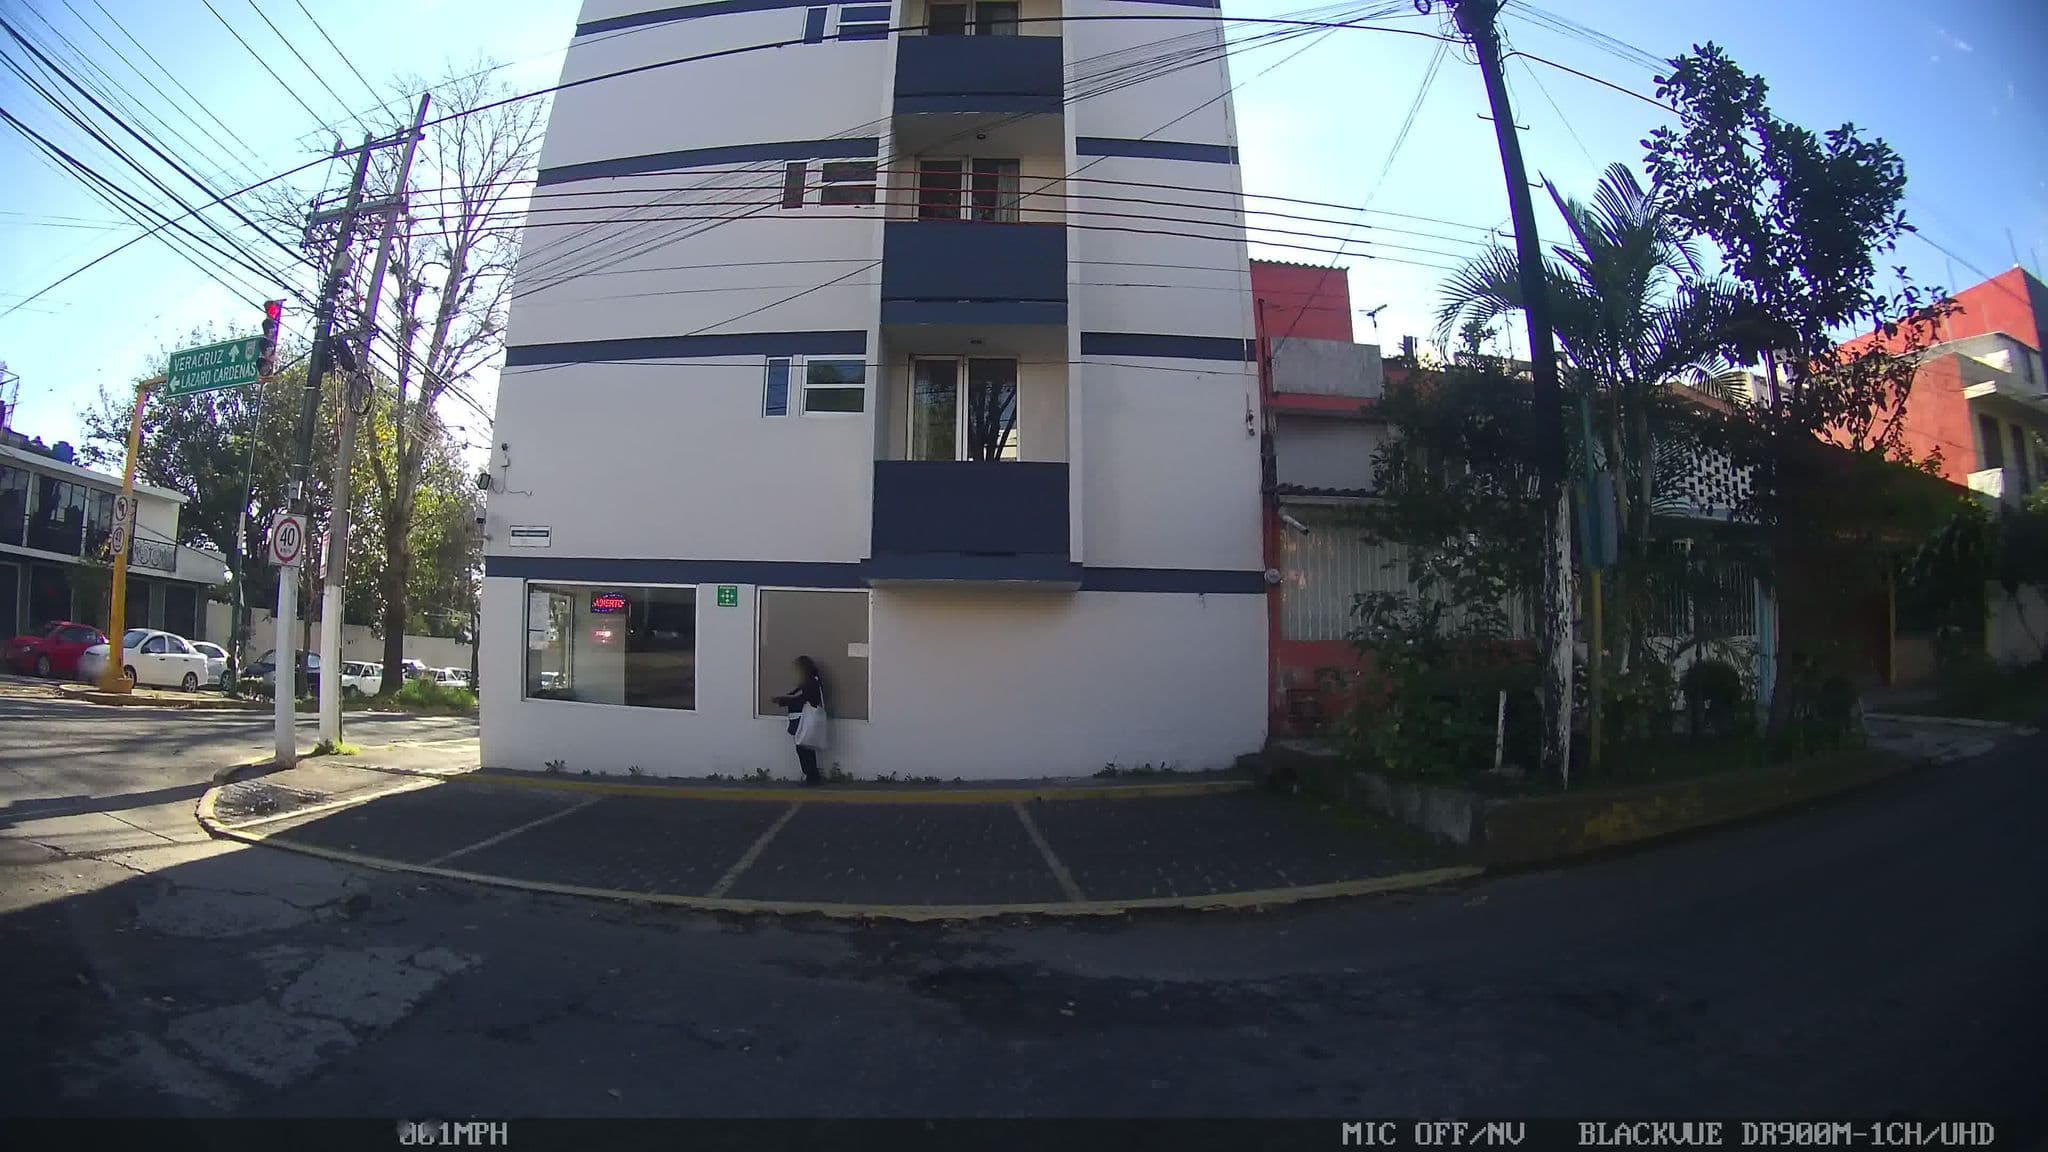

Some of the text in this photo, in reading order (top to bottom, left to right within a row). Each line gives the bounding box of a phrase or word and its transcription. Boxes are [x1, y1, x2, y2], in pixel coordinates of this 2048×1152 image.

[174, 349, 225, 372] VERACRUZ
[181, 361, 257, 389] LAZARO CARDENAS
[279, 527, 295, 546] 40
[591, 597, 625, 608] ABIERTO
